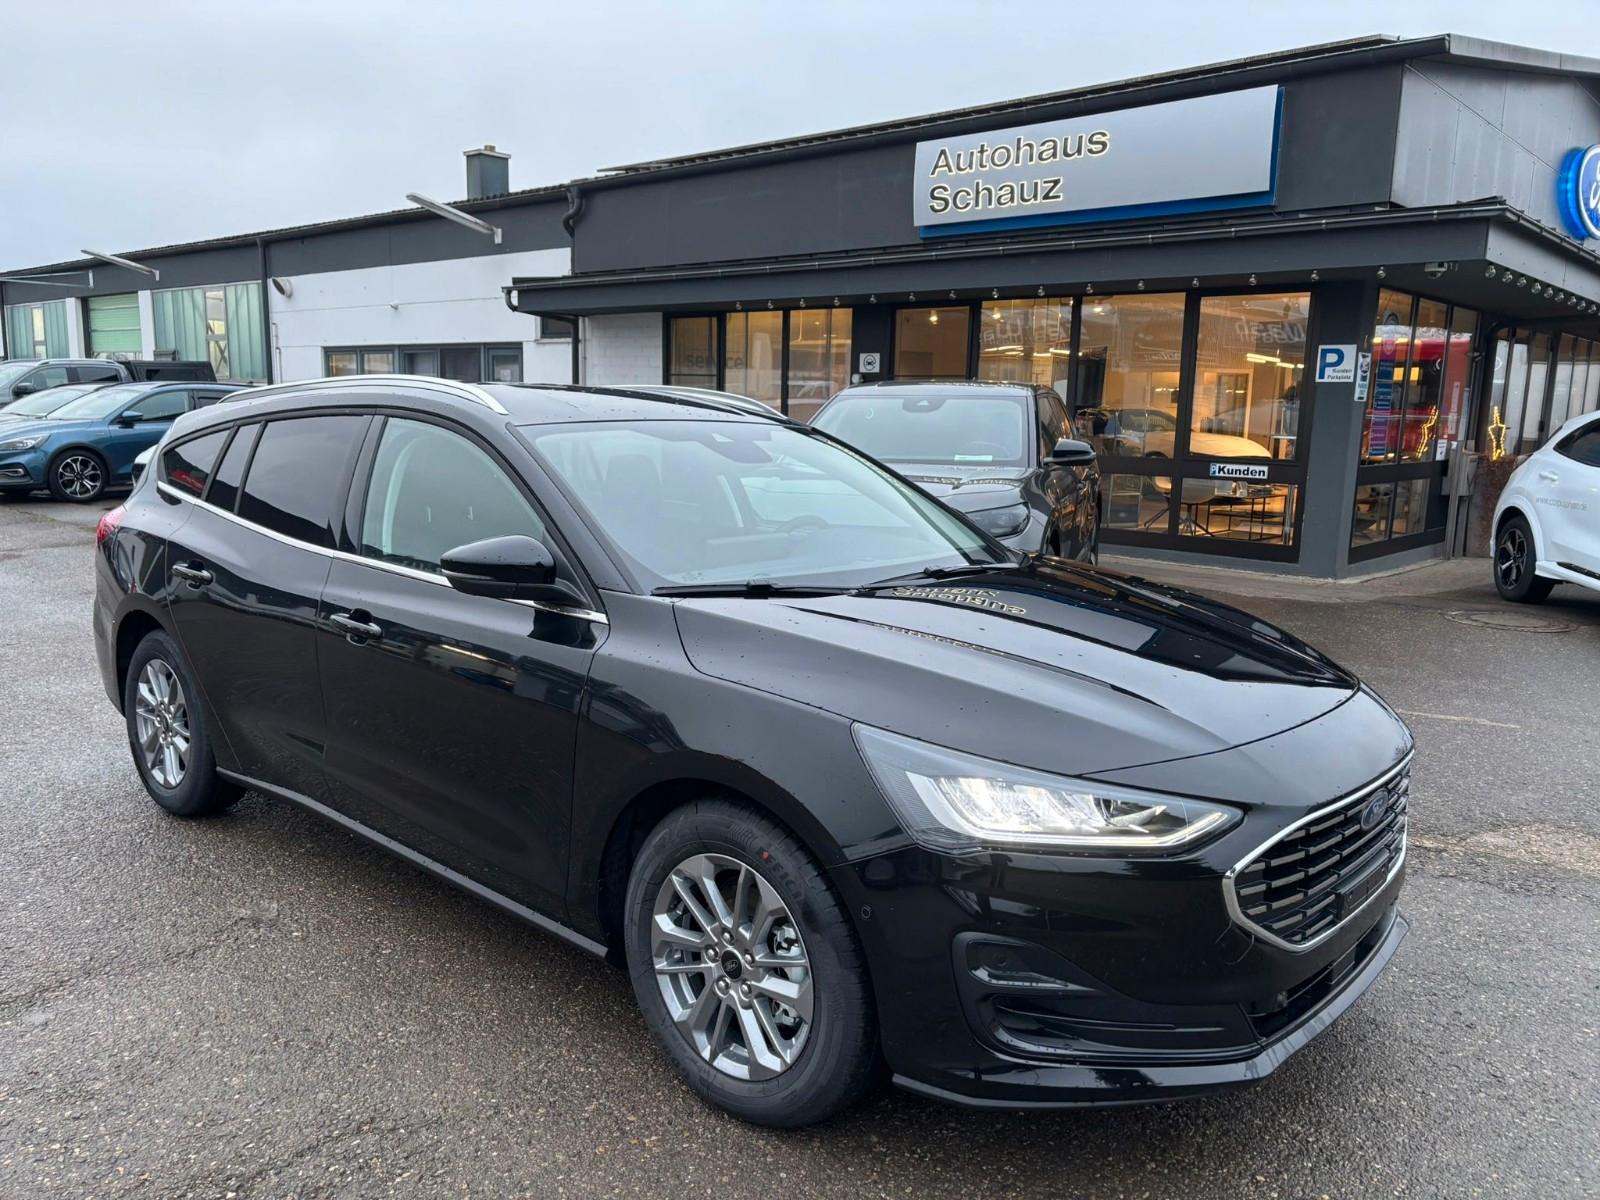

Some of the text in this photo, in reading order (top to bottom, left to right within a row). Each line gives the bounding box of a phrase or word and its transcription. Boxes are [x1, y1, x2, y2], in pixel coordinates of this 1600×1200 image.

[929, 129, 1110, 177] Autohaus
[928, 176, 1064, 214] Schauz
[1318, 348, 1344, 379] P
[1217, 465, 1266, 477] Kunden
